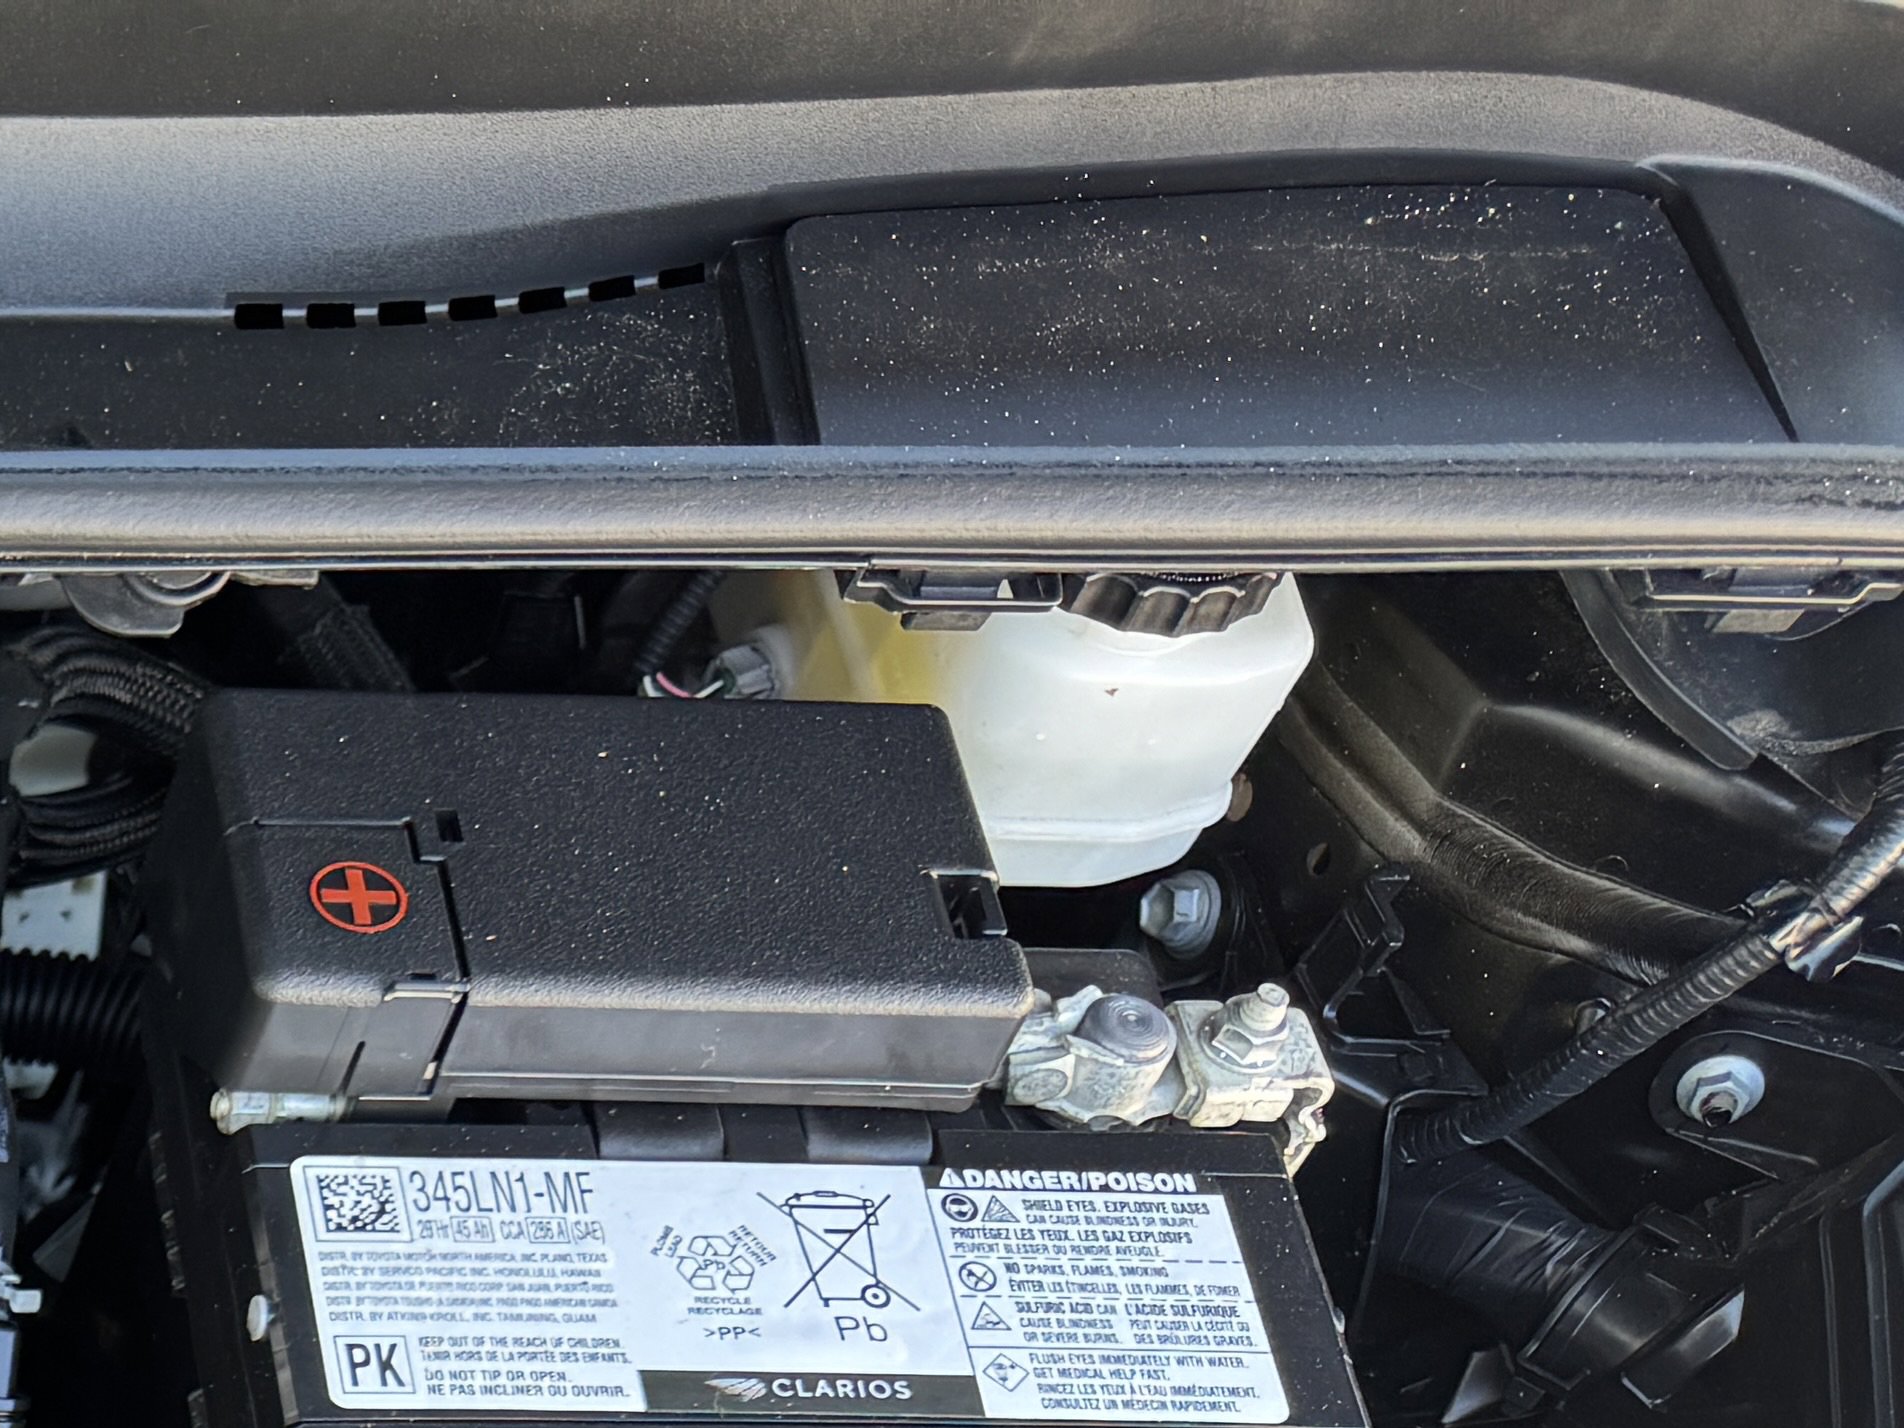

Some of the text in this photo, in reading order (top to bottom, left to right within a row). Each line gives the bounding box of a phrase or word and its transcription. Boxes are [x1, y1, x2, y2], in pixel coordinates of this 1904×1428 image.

[409, 1170, 593, 1215] 345LN1-MF
[962, 1169, 1197, 1193] DANGER/POISON
[694, 1297, 751, 1305] RECYCLE
[835, 1316, 888, 1342] Pb
[346, 1343, 405, 1388] PK
[772, 1379, 912, 1399] CLARIOS
